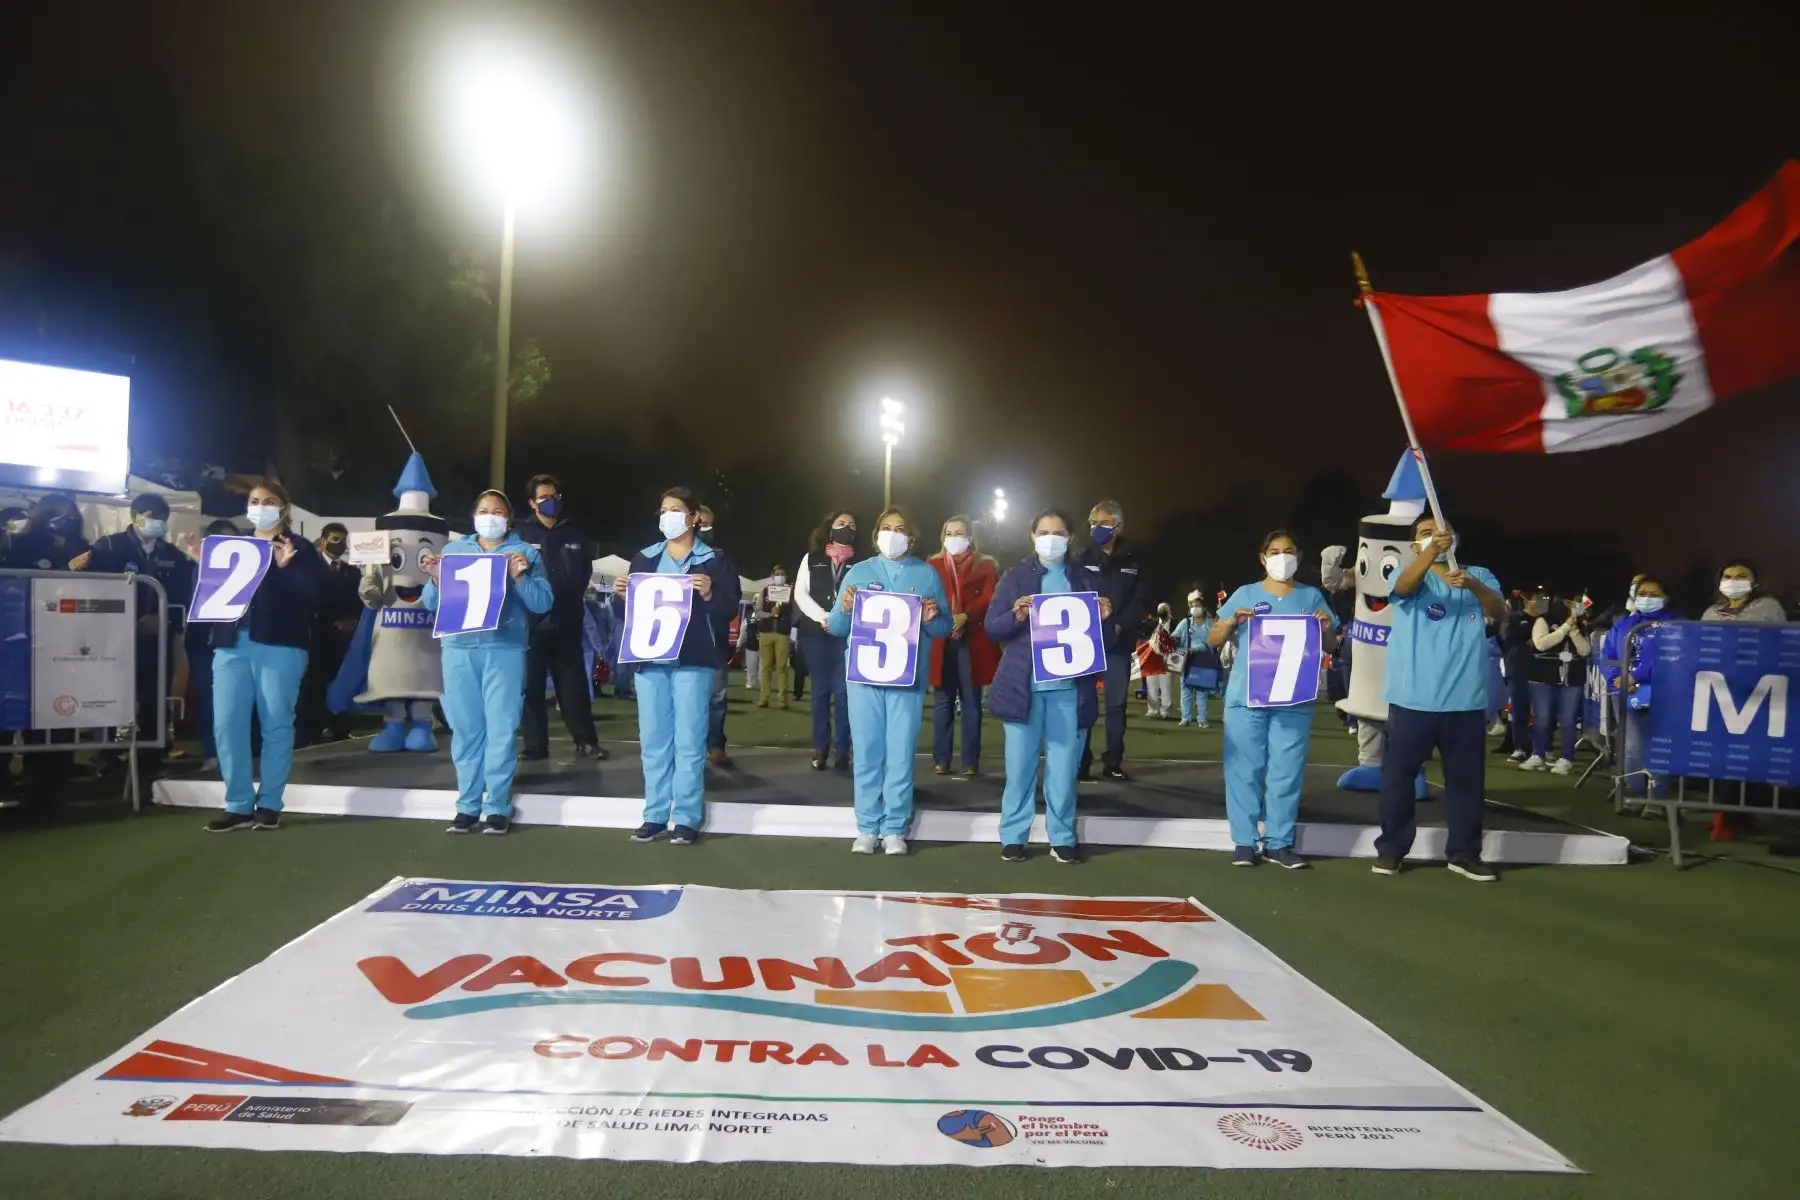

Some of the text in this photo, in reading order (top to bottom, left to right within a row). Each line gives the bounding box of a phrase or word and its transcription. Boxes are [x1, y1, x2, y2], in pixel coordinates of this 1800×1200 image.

[198, 540, 260, 619] 2
[455, 557, 493, 629] 1
[384, 611, 435, 624] MINSA
[630, 576, 683, 659] 6
[857, 595, 911, 681] 3
[1039, 597, 1095, 676] 3
[1262, 619, 1307, 702] 7
[1691, 671, 1789, 738] M
[415, 886, 640, 909] MINSA
[400, 902, 633, 918] DIRIS LIMA NORTE
[533, 1034, 1313, 1073] CONTRA LA COVID-19
[183, 1101, 312, 1114] PERÚ Ministerio
[238, 1111, 295, 1120] de Salud
[545, 1105, 829, 1122] CCIÓN DE REDES INTEGRADAS
[586, 1119, 650, 1132] SALUD
[653, 1121, 703, 1133] LIMA
[708, 1123, 773, 1135] NORTE
[1018, 1115, 1065, 1123] Pongo
[1025, 1129, 1109, 1138] por el Perú
[1307, 1125, 1421, 1134] BICENTENARIO
